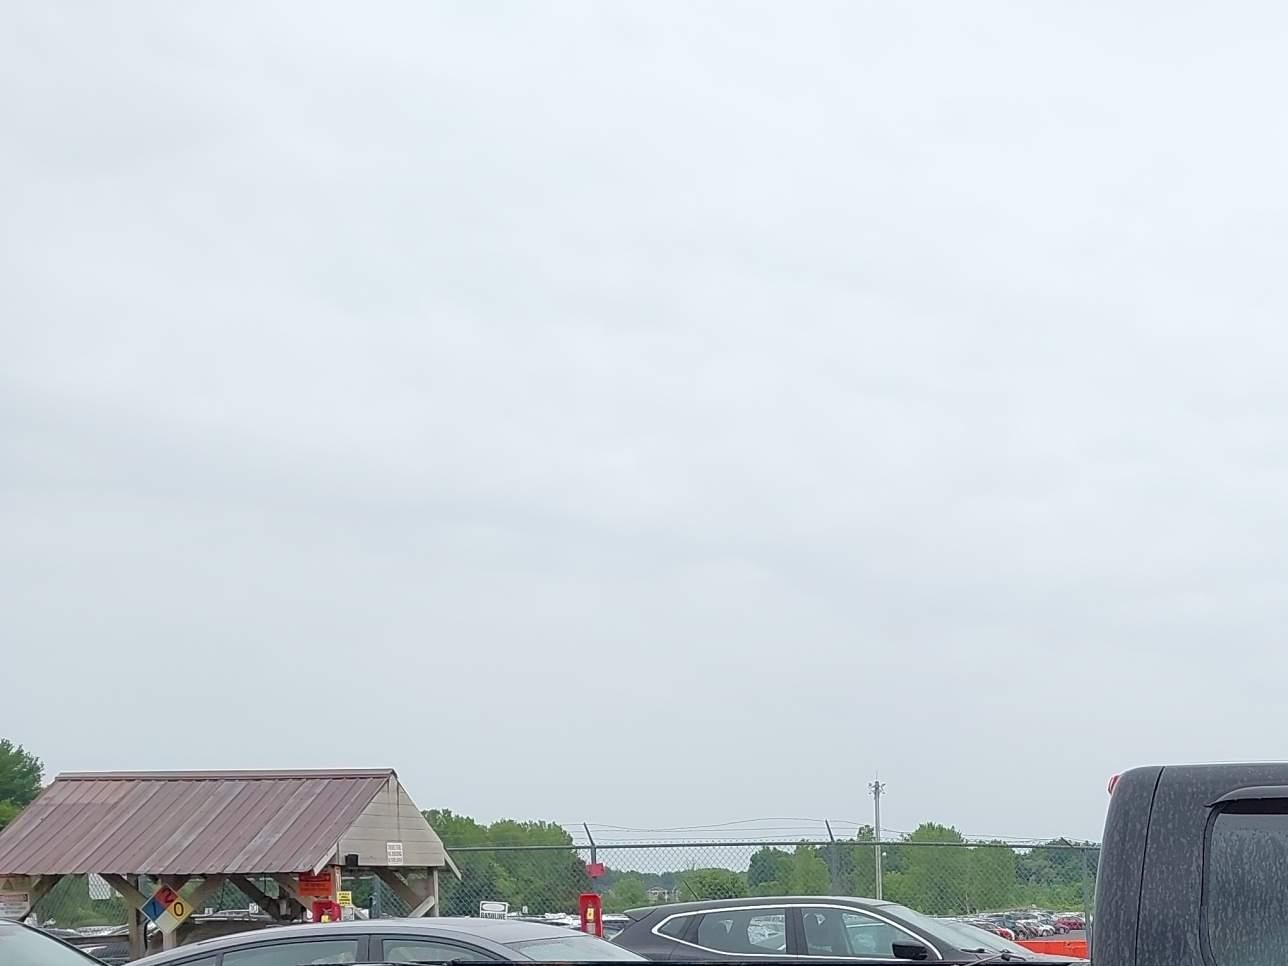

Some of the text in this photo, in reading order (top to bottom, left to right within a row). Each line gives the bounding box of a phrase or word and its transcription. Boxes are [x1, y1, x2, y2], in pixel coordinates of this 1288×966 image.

[164, 889, 175, 903] 2
[173, 901, 185, 917] 0
[480, 911, 506, 920] GASOLINE
